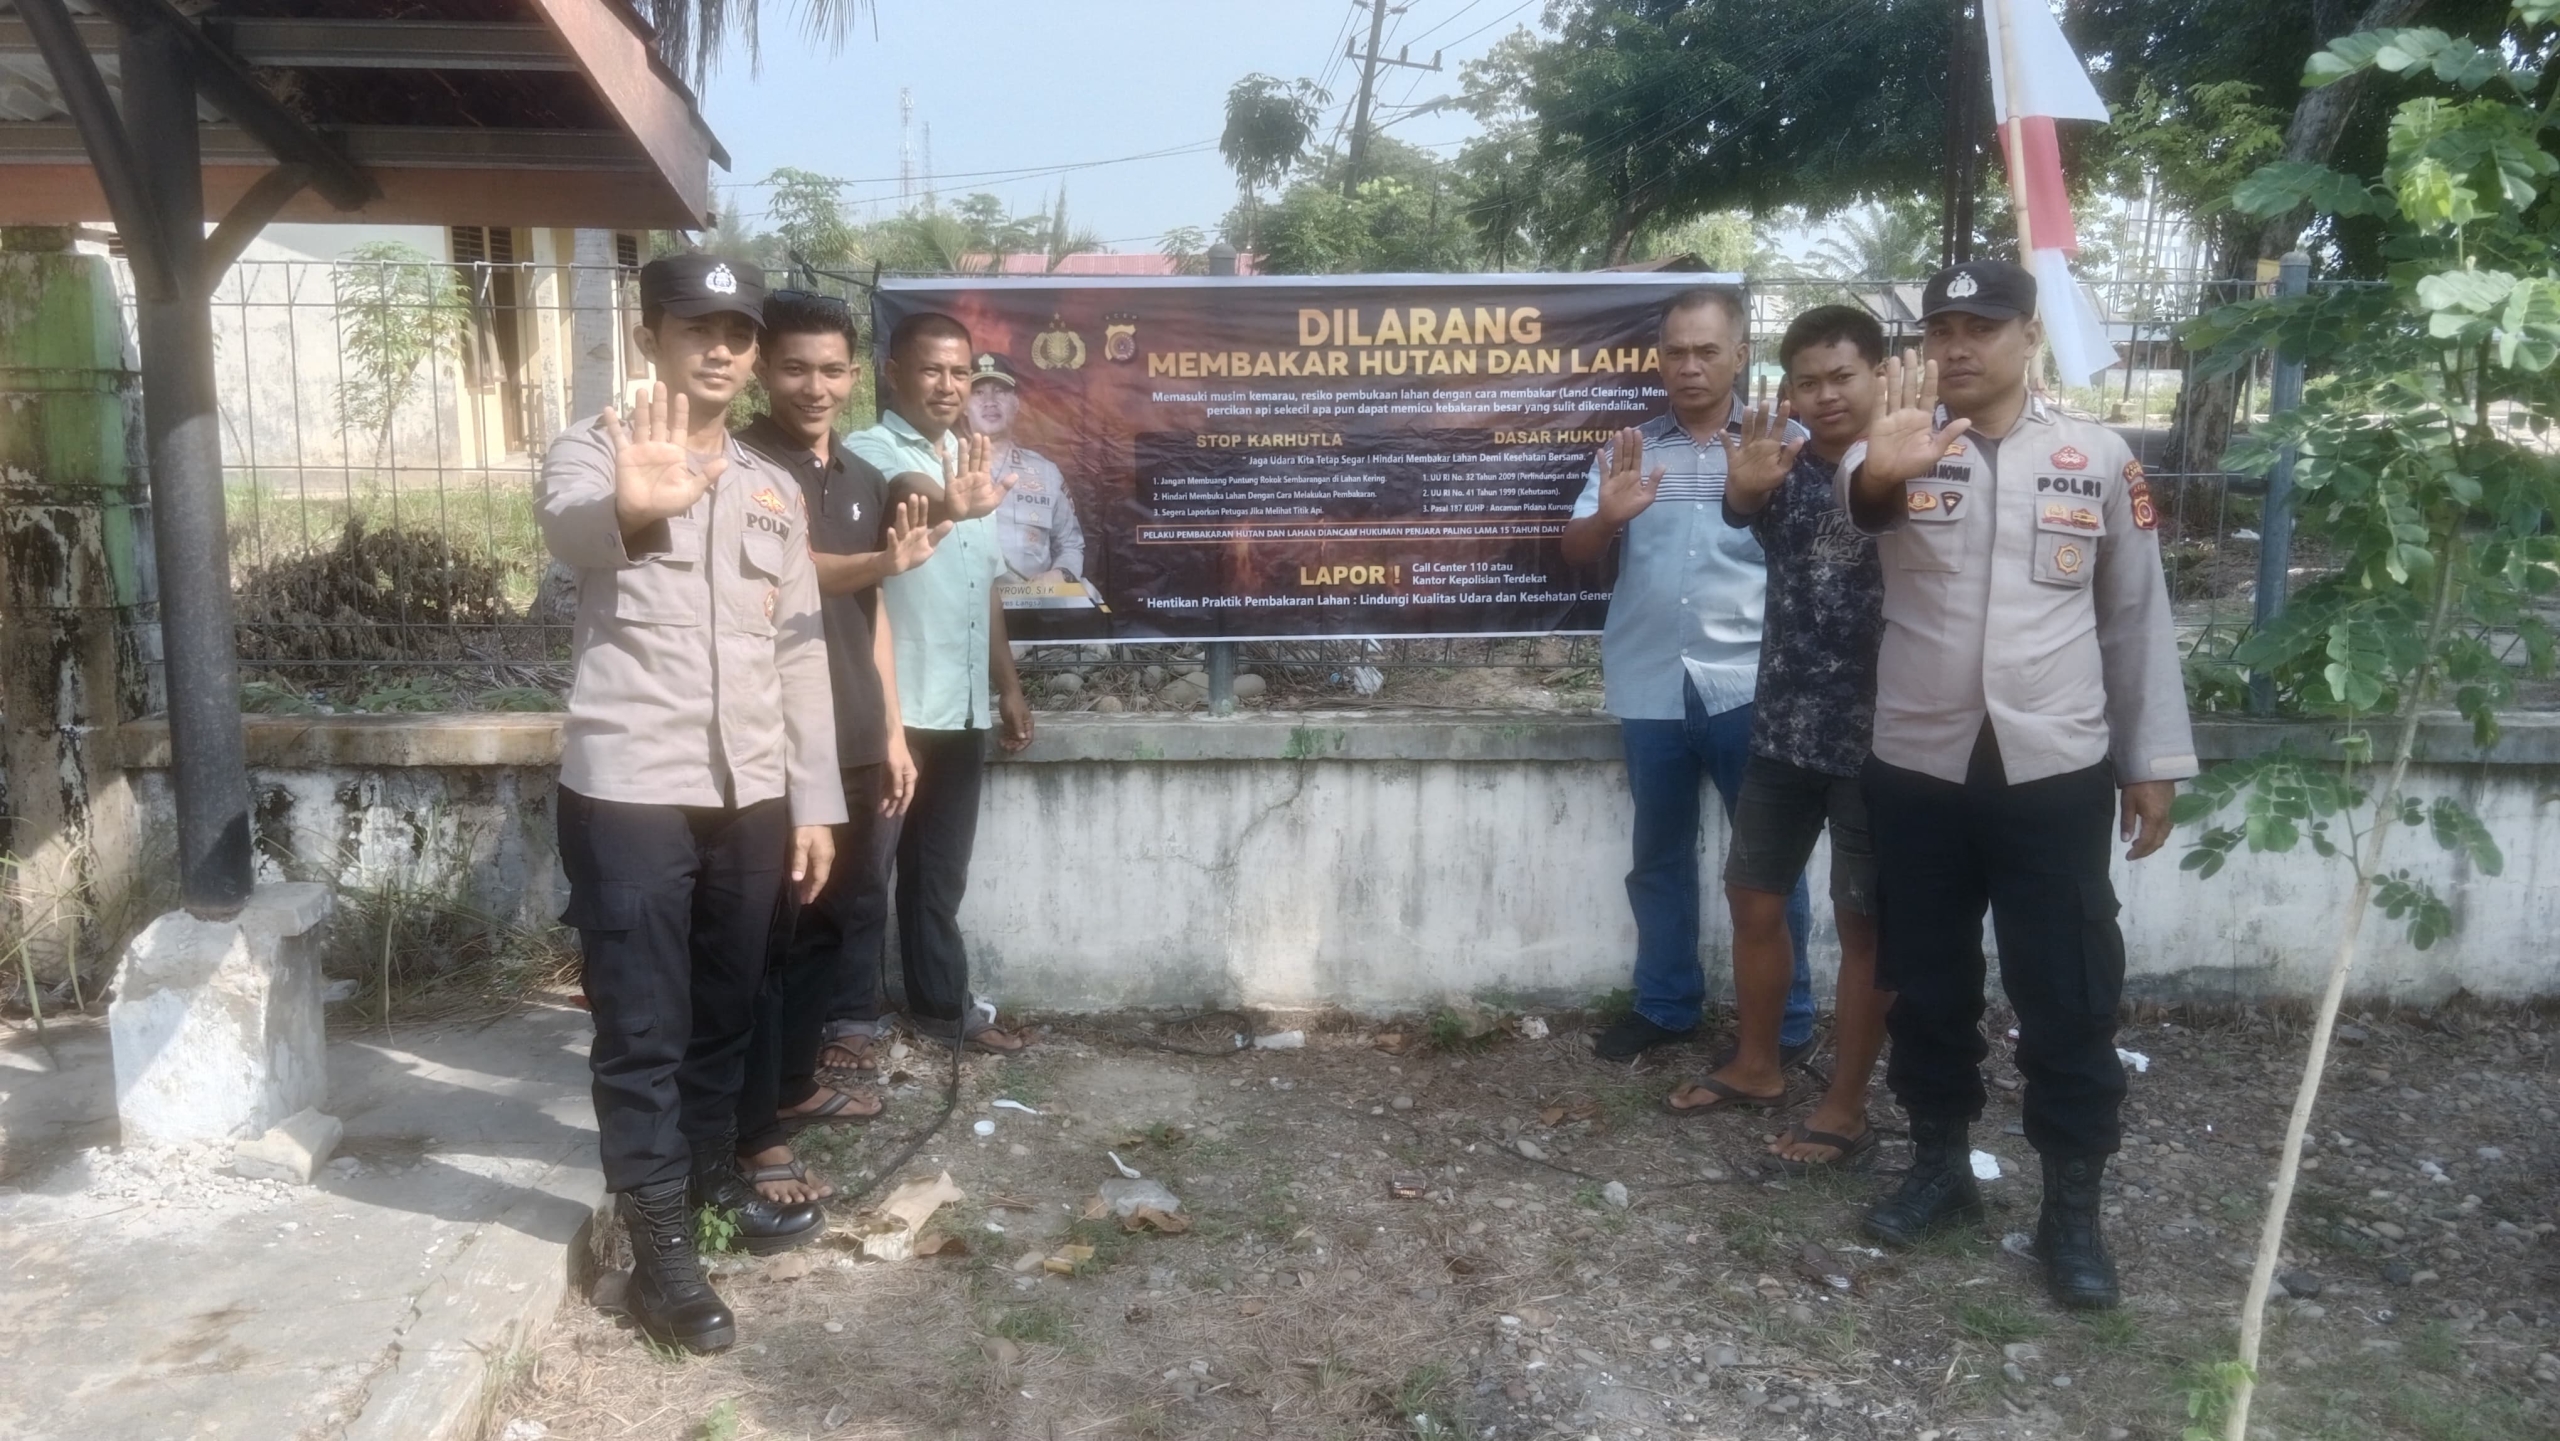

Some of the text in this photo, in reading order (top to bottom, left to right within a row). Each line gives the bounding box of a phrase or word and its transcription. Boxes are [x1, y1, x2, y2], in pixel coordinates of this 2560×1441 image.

[1299, 307, 1541, 346] DILARANG
[1148, 348, 1661, 378] MEMBAKAR HUTAN DAN LAHA
[1153, 391, 1208, 401] Memasuki
[1211, 391, 1247, 401] musim
[1250, 391, 1299, 401] kemarau,
[1302, 390, 1333, 400] resiko
[1336, 389, 1399, 402] pembukaan
[1401, 389, 1430, 399] lahan
[1433, 389, 1473, 401] dengan
[1500, 388, 1557, 398] membakar
[1559, 387, 1589, 399] (Land
[1591, 387, 1639, 399] Clearing)
[1642, 387, 1669, 396] Men
[1207, 405, 1253, 417] percikan
[1255, 405, 1272, 417] api
[1274, 404, 1310, 414] sekecil
[1312, 407, 1332, 416] apa
[1334, 406, 1355, 416] pun
[1358, 404, 1389, 416] dapat
[1436, 403, 1491, 412] kebakaran
[1493, 401, 1523, 412] besar
[1525, 403, 1551, 414] yang
[1553, 401, 1576, 411] sulit
[1579, 401, 1649, 411] dikendalikan.
[1196, 433, 1343, 448] STOP KARHUTLA
[1494, 430, 1551, 445] DASAR
[1249, 457, 1268, 467] Jaga
[1270, 456, 1296, 464] Udara
[1298, 456, 1315, 464] Kita
[1317, 455, 1340, 466] Tetap
[1341, 455, 1366, 466] Segar
[1373, 454, 1404, 463] Hindari
[1406, 454, 1451, 462] Membakar
[1453, 453, 1478, 462] Lahan
[1480, 453, 1501, 462] Demi
[1504, 453, 1547, 461] Kesehatan
[1161, 478, 1186, 486] Jangan
[1188, 477, 1227, 485] Membuang
[1229, 477, 1259, 485] Puntung
[1284, 475, 1331, 484] Sembarangan
[2037, 477, 2102, 498] POLRI
[1017, 494, 1050, 506] POLRI
[1248, 492, 1275, 501] Dengan
[1162, 509, 1186, 518] Segera
[1187, 508, 1220, 517] Laporkan
[1221, 508, 1249, 517] Petugas
[1548, 504, 1575, 512] Kurung
[745, 511, 790, 542] POLRI
[1177, 530, 1234, 538] PEMBAKARAN
[1413, 563, 1514, 572] Call Center 110 atau
[1300, 566, 1386, 586] LAPOR
[1413, 574, 1548, 586] Kantor Kepolisian Terdekat
[1148, 597, 1199, 607] Hentikan
[1202, 596, 1242, 607] Praktik
[1245, 595, 1314, 606] Pembakaran
[1318, 595, 1350, 605] Lahan
[1360, 594, 1410, 607] Lindungi
[1413, 593, 1457, 603] Kualitas
[1460, 593, 1493, 603] Udara
[1496, 592, 1517, 602] dan
[1520, 591, 1577, 602] Kesehatan
[1580, 591, 1613, 601] Gener
